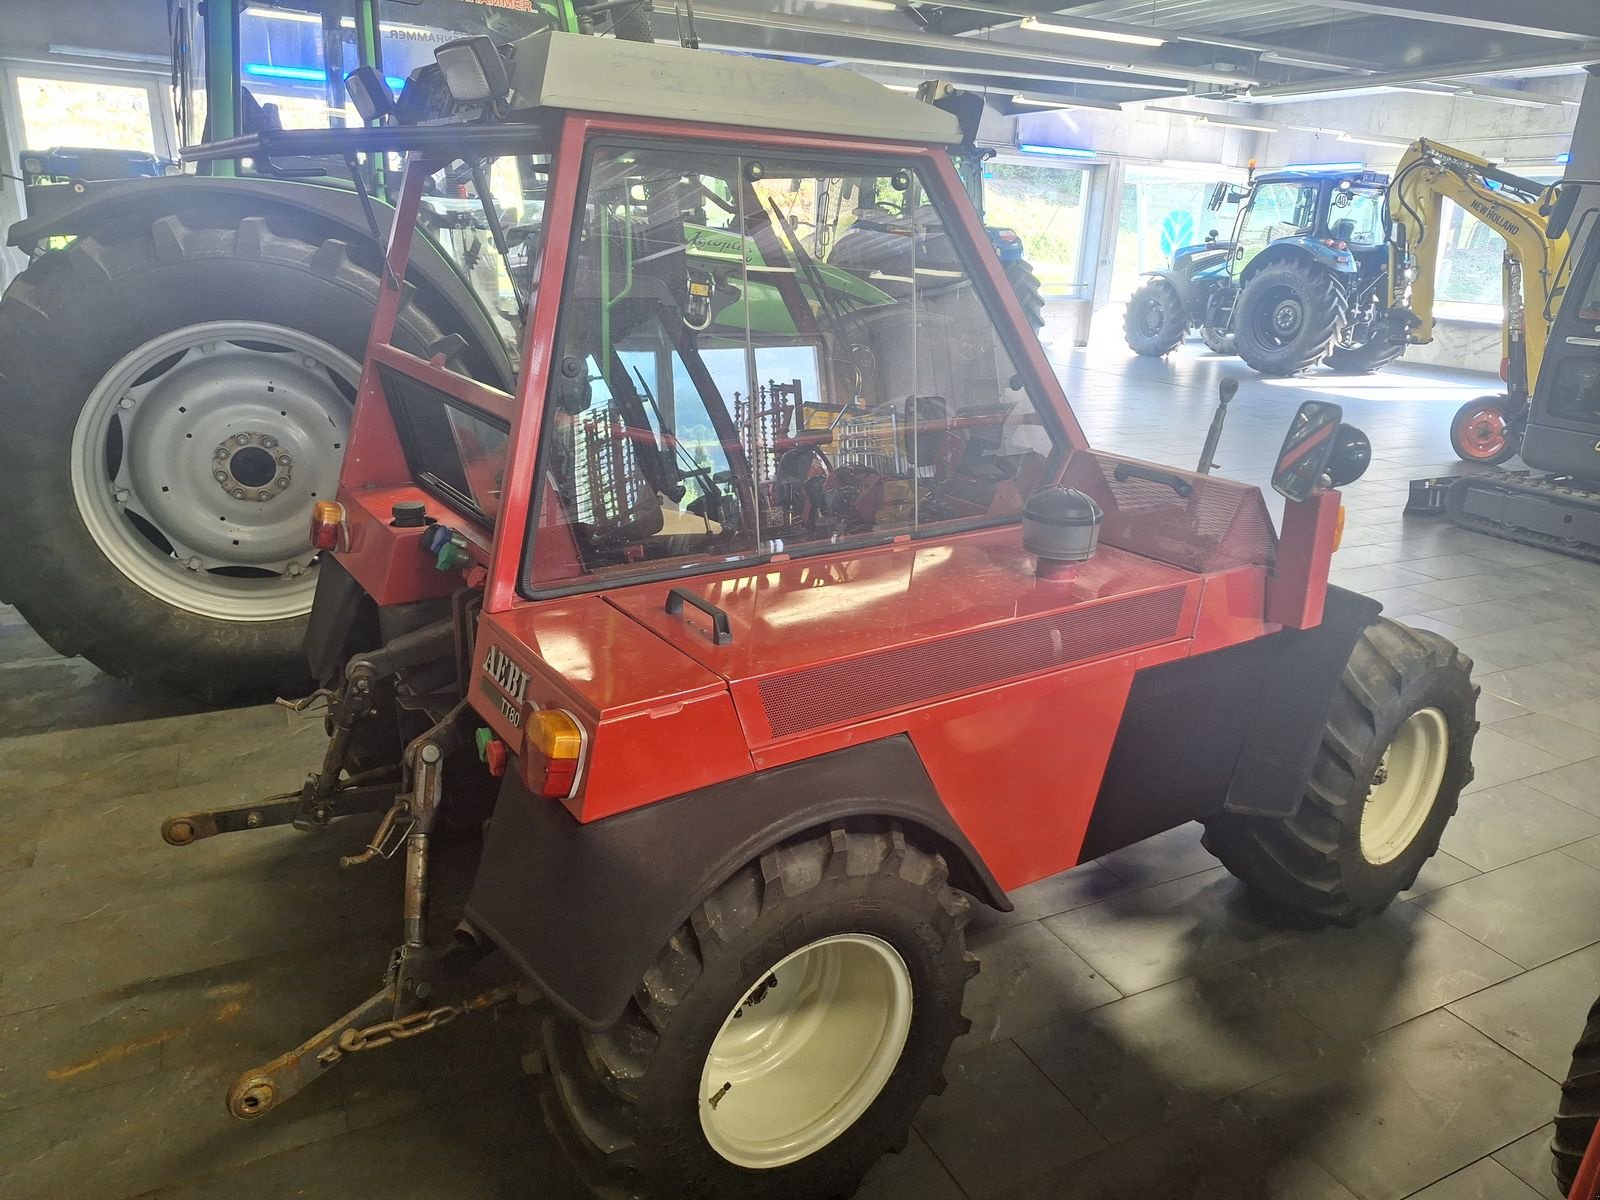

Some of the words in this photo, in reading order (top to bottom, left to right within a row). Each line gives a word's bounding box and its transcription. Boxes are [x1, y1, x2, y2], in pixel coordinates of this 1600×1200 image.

[465, 0, 533, 12] AMMER
[1337, 195, 1346, 206] 40
[1470, 199, 1487, 215] NEW
[1486, 208, 1520, 235] HOLLAND
[482, 644, 531, 704] AEBI
[501, 697, 521, 728] TT80
